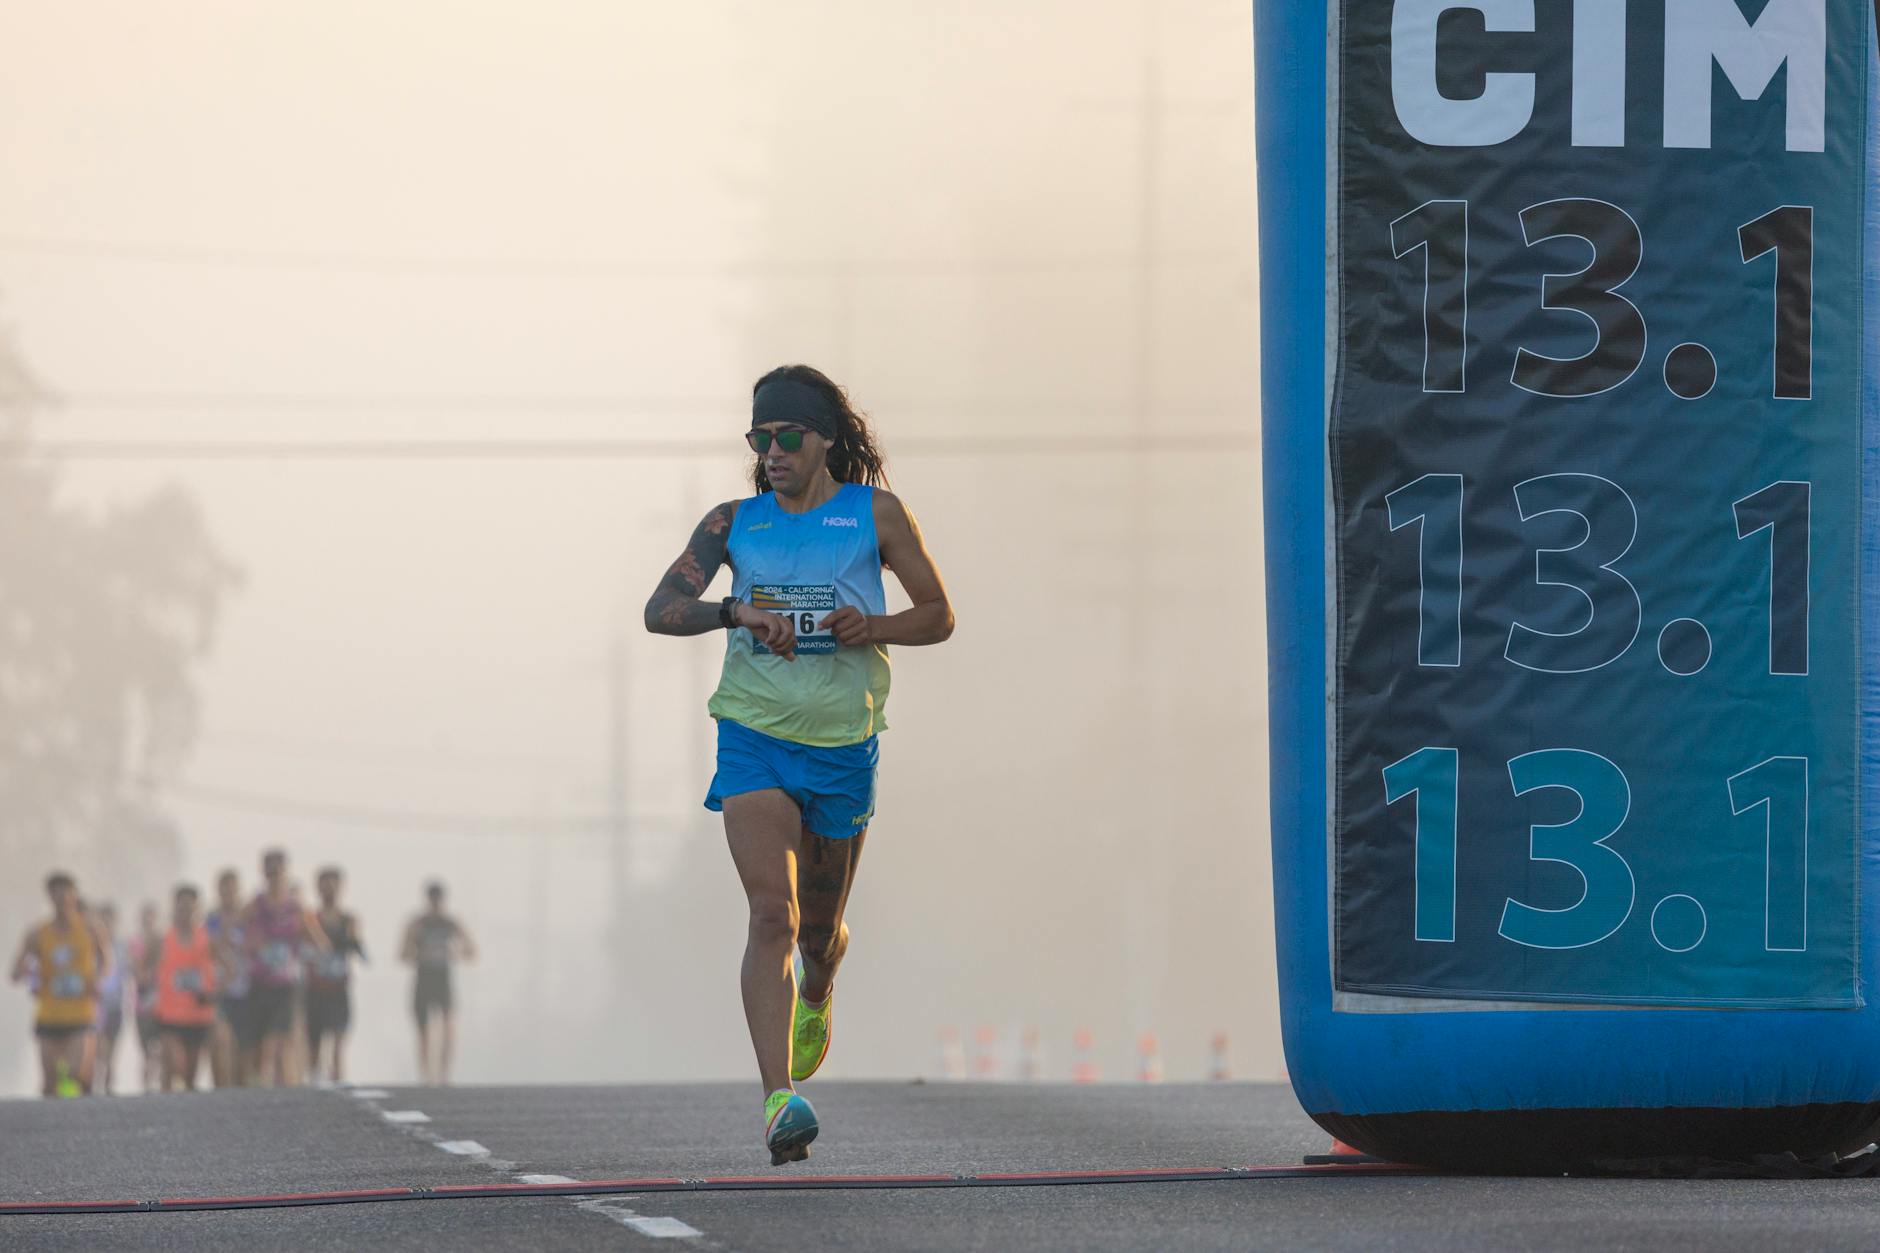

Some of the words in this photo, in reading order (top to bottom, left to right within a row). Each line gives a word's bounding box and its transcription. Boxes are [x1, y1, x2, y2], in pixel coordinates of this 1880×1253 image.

[1391, 0, 1826, 152] CIM
[1390, 198, 1813, 400] 13.1
[822, 516, 858, 528] HOKA
[763, 586, 783, 594] 2024
[788, 586, 834, 594] CALIFORNIA
[774, 593, 833, 601] INTERNATIONAL
[790, 600, 834, 608] MARATHON
[1385, 473, 1811, 675] 13.1
[1382, 747, 1808, 952] 13.1
